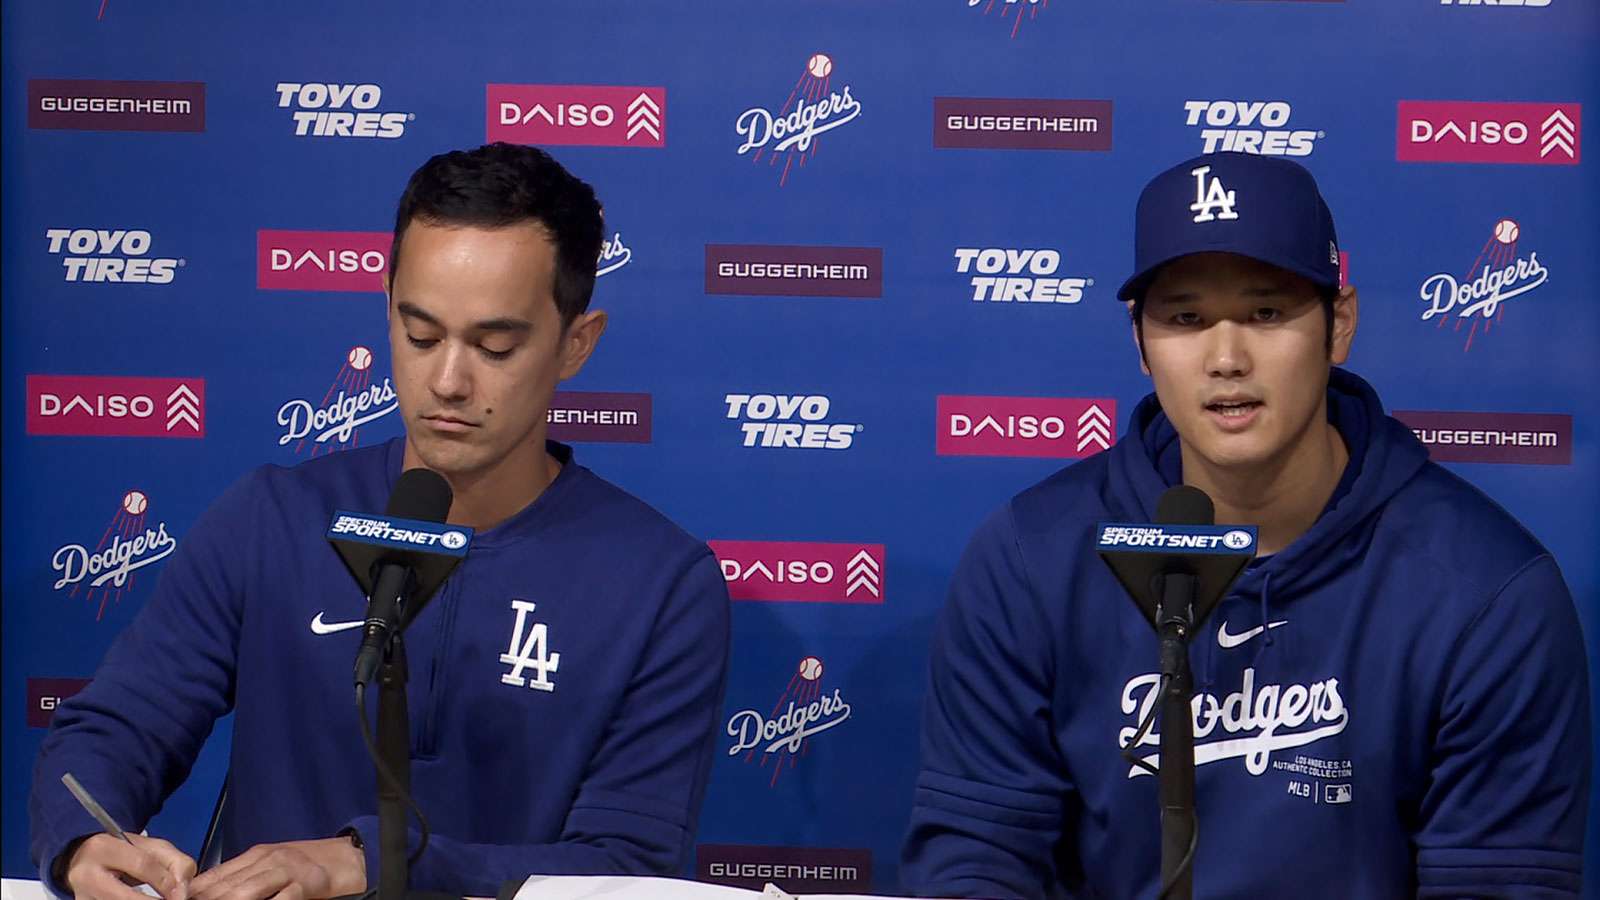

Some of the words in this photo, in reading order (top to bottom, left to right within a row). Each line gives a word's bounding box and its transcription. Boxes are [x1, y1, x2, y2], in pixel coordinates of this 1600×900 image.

[41, 97, 191, 114] GUGGENHEIM
[276, 83, 381, 110] TOYO
[500, 103, 614, 127] DAISO
[736, 85, 861, 155] Dodgers
[947, 116, 1098, 132] GUGGENHEIM
[1184, 101, 1291, 127] TOYO
[1411, 120, 1528, 144] DAISO
[1190, 165, 1239, 223] LA
[46, 229, 152, 256] TOYO
[271, 249, 385, 273] DAISO
[718, 263, 868, 279] GUGGENHEIM
[954, 248, 1060, 275] TOYO
[1420, 251, 1548, 320] Dodgers
[40, 394, 154, 418] DAISO
[277, 378, 399, 445] Dodgers
[725, 394, 830, 421] TOYO
[950, 414, 1065, 439] DAISO
[332, 521, 441, 545] SPORTSNET
[338, 516, 391, 528] SPECTRUM
[1104, 527, 1163, 536] SPECTRUM
[1100, 533, 1222, 548] SPORTSNET
[1231, 534, 1244, 546] LA
[52, 522, 177, 590] Dodgers
[720, 559, 834, 583] DAISO
[499, 600, 560, 692] LA
[727, 688, 851, 756] Dodgers
[1287, 780, 1311, 797] MLB
[709, 863, 857, 880] GUGGENHEIM
